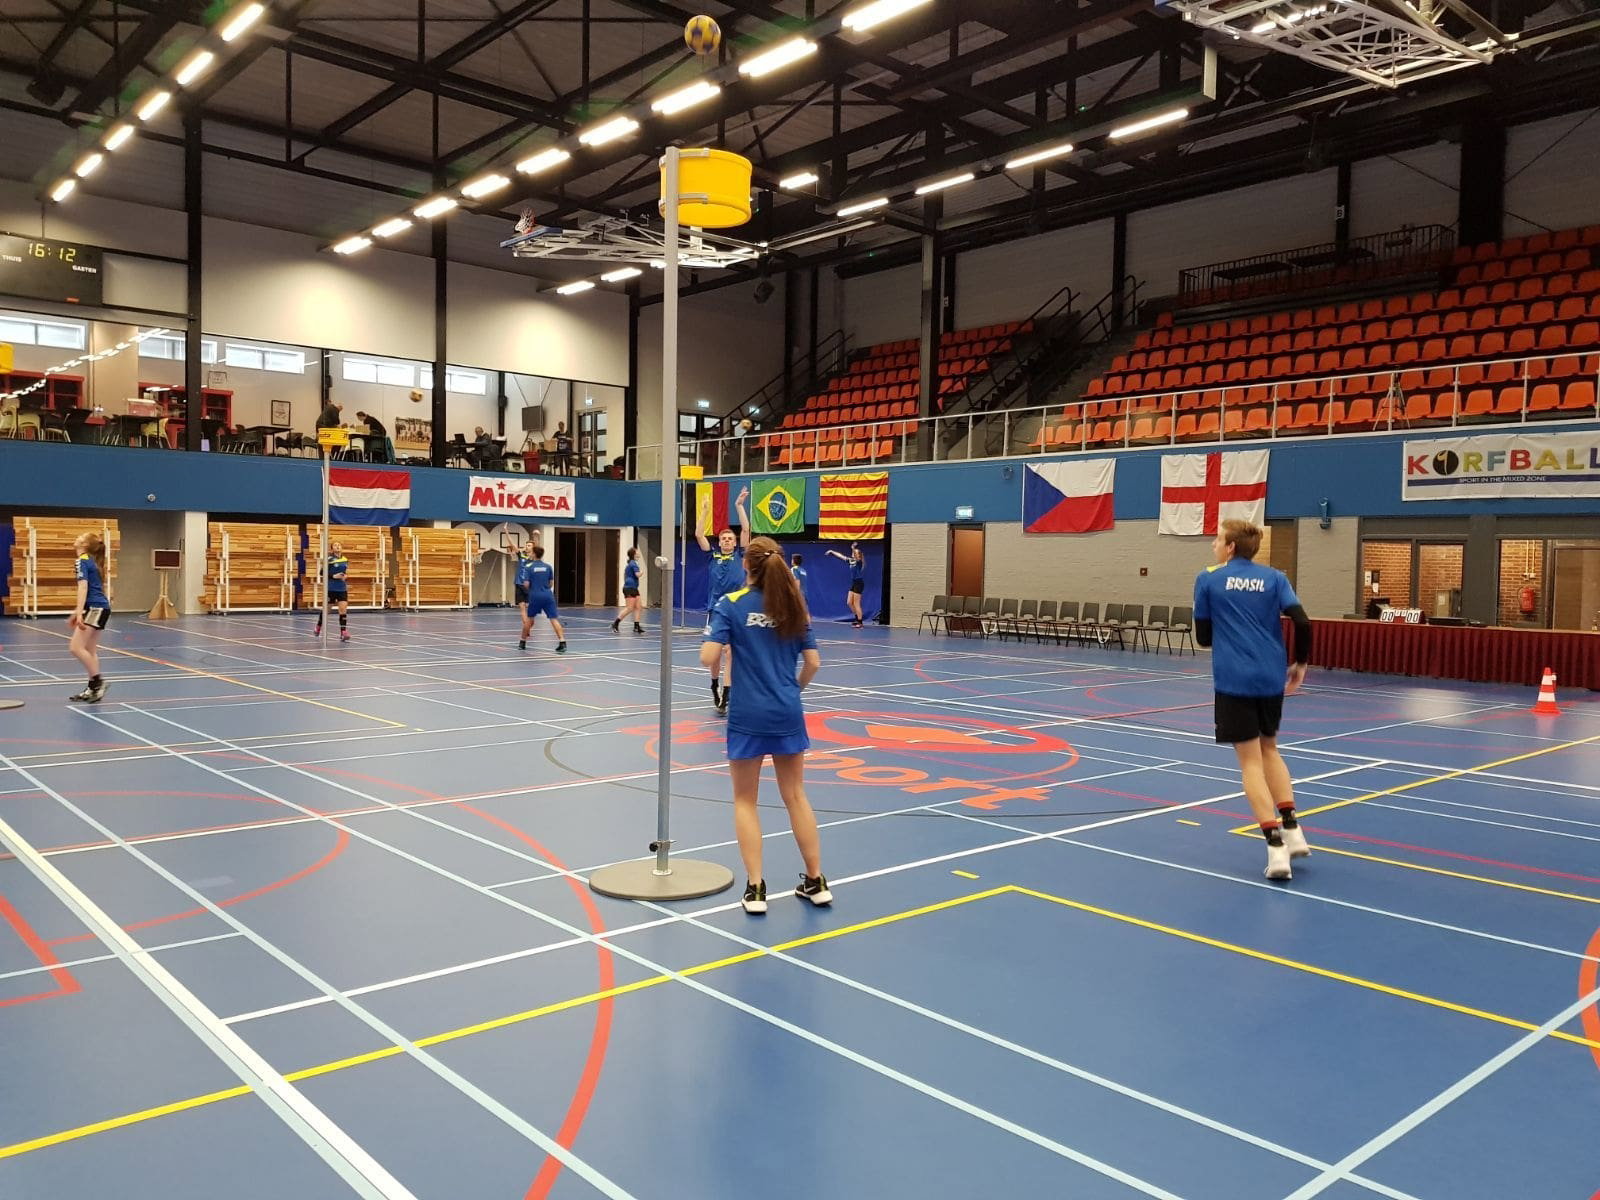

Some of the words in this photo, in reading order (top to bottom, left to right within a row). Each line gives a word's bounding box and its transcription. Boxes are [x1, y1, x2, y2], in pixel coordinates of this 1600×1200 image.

[2, 254, 22, 262] THUIS
[28, 243, 76, 262] 16:12
[1407, 447, 1600, 476] KORFBALL
[1226, 576, 1265, 592] BRASIL
[762, 750, 1053, 810] port
